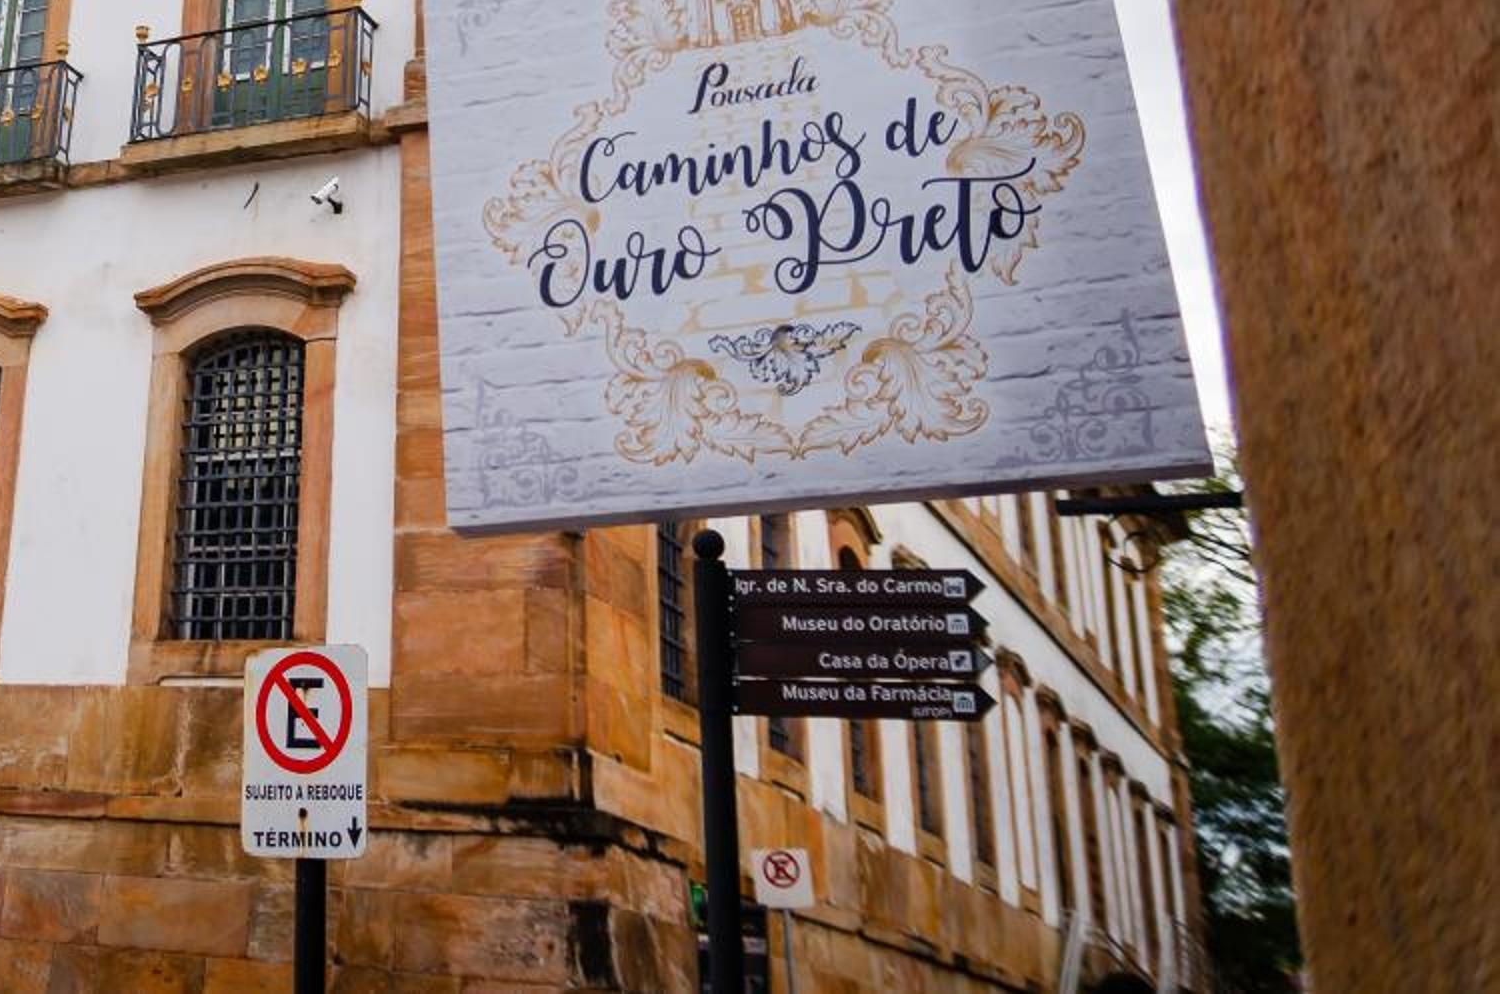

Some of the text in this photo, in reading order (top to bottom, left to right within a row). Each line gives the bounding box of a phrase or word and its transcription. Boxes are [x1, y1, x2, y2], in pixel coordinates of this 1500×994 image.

[688, 56, 820, 114] Pousada
[579, 97, 959, 204] Caminhos de
[527, 156, 1042, 308] Ouro Preto
[767, 578, 787, 593] de
[793, 579, 810, 593] N.
[816, 578, 851, 593] Sra.
[857, 578, 878, 593] do
[883, 578, 942, 594] Carmo
[782, 614, 945, 633] Museu do Oratório
[819, 649, 949, 672] Casa da Ópera
[782, 684, 951, 702] Museu da Farmácia
[245, 785, 363, 801] SUJEITO A REBOQUE
[253, 827, 342, 847] TÉRMINO
